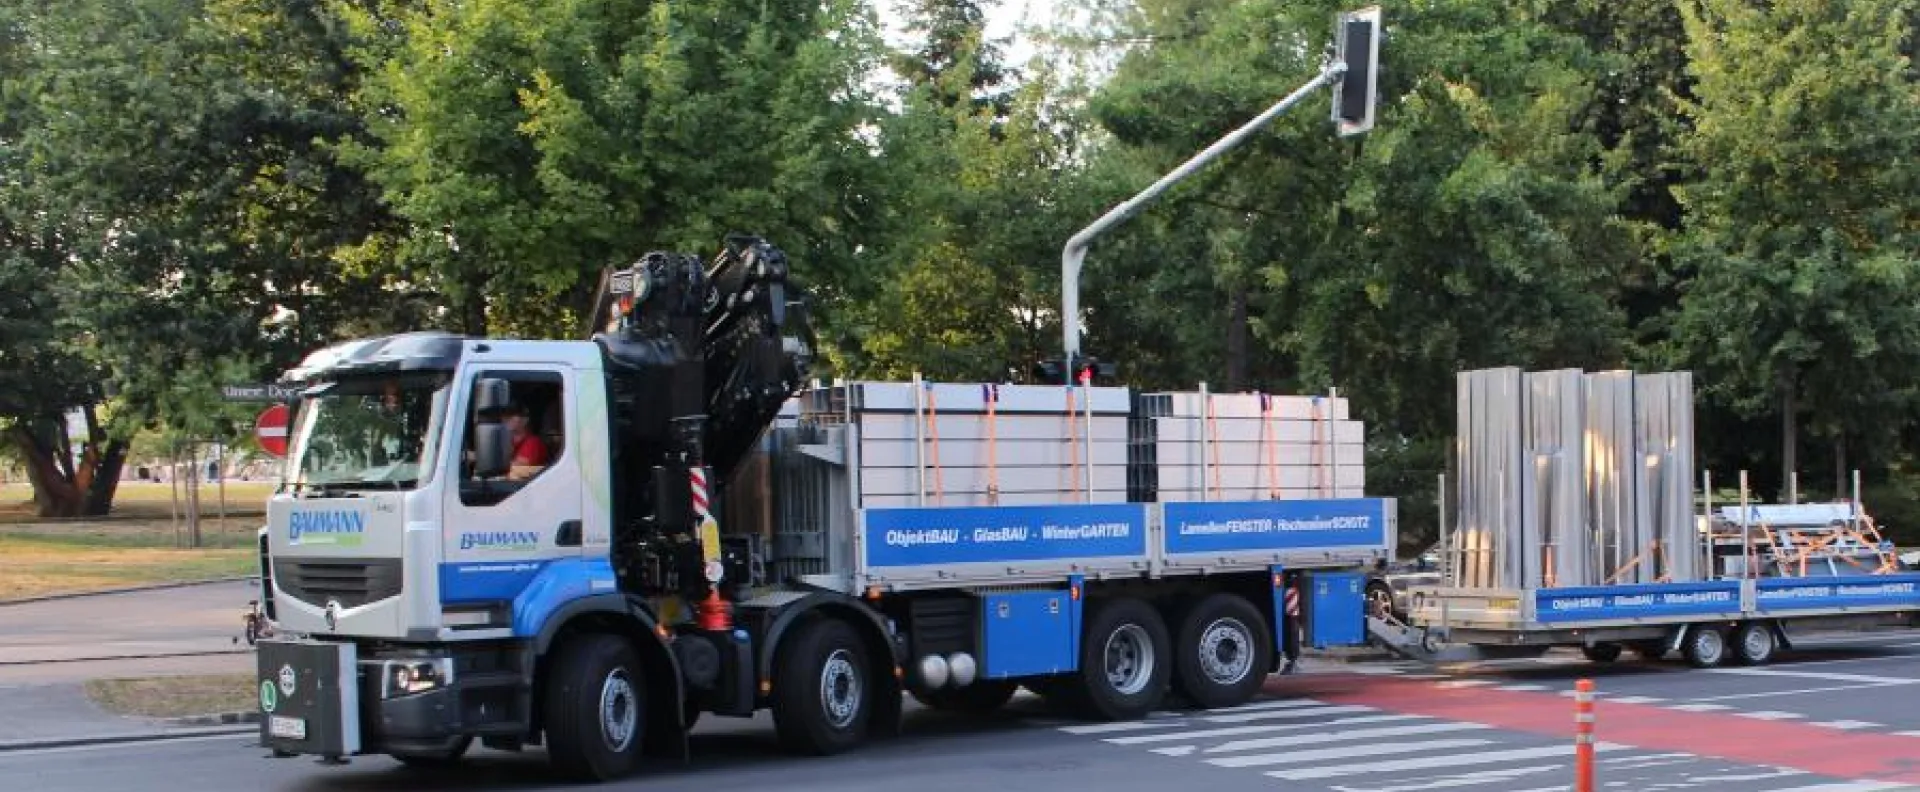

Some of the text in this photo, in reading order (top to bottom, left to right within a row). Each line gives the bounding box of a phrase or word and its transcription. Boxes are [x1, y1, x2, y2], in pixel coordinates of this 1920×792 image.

[289, 508, 365, 540] BAUMANN
[886, 529, 958, 548] ObjektBAU
[973, 527, 1028, 542] GlasBAU
[1041, 523, 1130, 540] WinterGARTEN
[460, 531, 540, 550] BAUMANN
